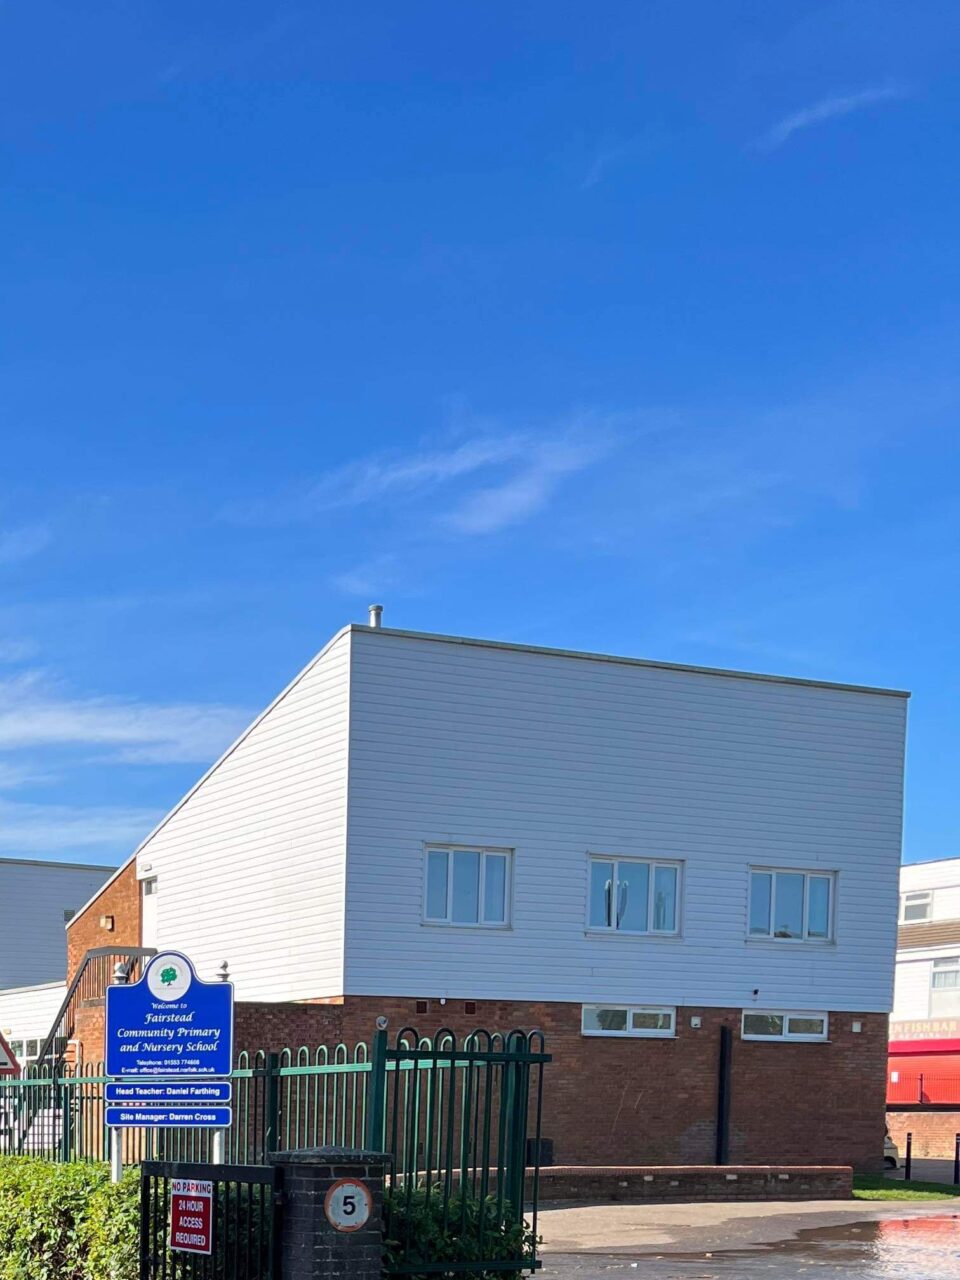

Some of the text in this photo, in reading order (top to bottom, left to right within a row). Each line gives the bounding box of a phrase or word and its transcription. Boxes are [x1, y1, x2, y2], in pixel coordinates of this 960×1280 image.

[152, 1002, 178, 1010] Welcome
[144, 1012, 195, 1024] Fairstead
[117, 1027, 220, 1040] Community Primary
[120, 1041, 219, 1054] and Nursery School
[116, 1087, 220, 1096] Head Teacher: Daniel Farthing
[135, 1113, 168, 1121] Manager:
[172, 1181, 211, 1194] NO PARKING
[178, 1199, 204, 1213] 24 HOUR
[342, 1195, 356, 1216] 5
[179, 1216, 203, 1229] ACCESS
[175, 1232, 205, 1246] REQUIRED
